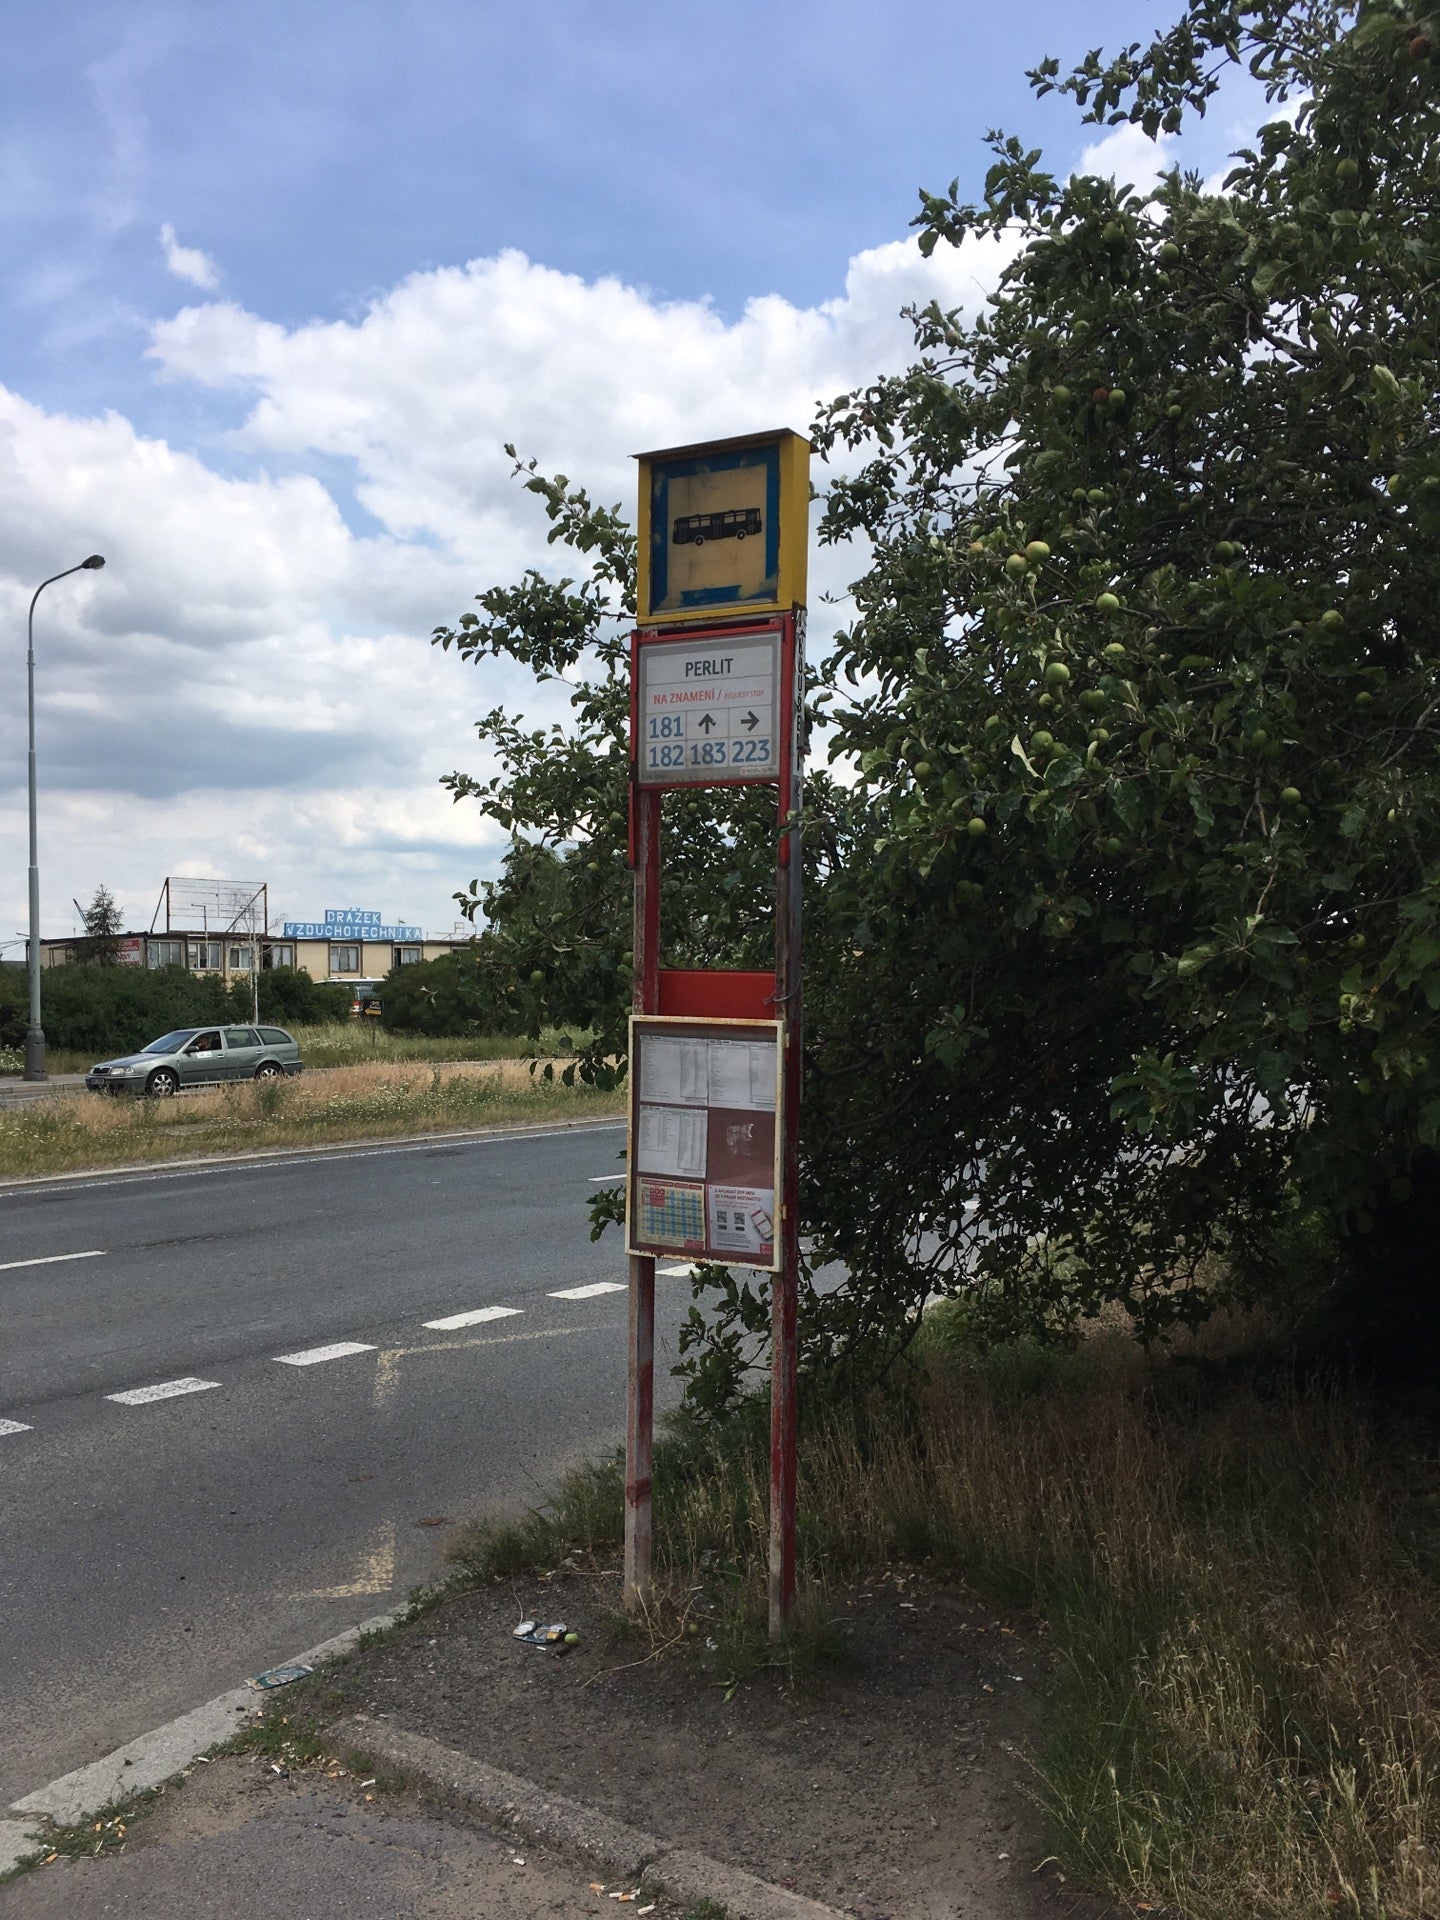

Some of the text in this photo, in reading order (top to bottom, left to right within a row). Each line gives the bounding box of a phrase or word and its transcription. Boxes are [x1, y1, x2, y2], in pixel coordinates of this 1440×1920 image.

[685, 658, 734, 677] PERLIT
[653, 694, 668, 705] NA
[670, 688, 715, 704] ZNAMENÍ
[649, 716, 684, 739] 181
[649, 739, 770, 768] 182 183 223
[326, 906, 381, 924] DRÁŽEK
[285, 923, 422, 939] VZDUCHOTECHNIKA
